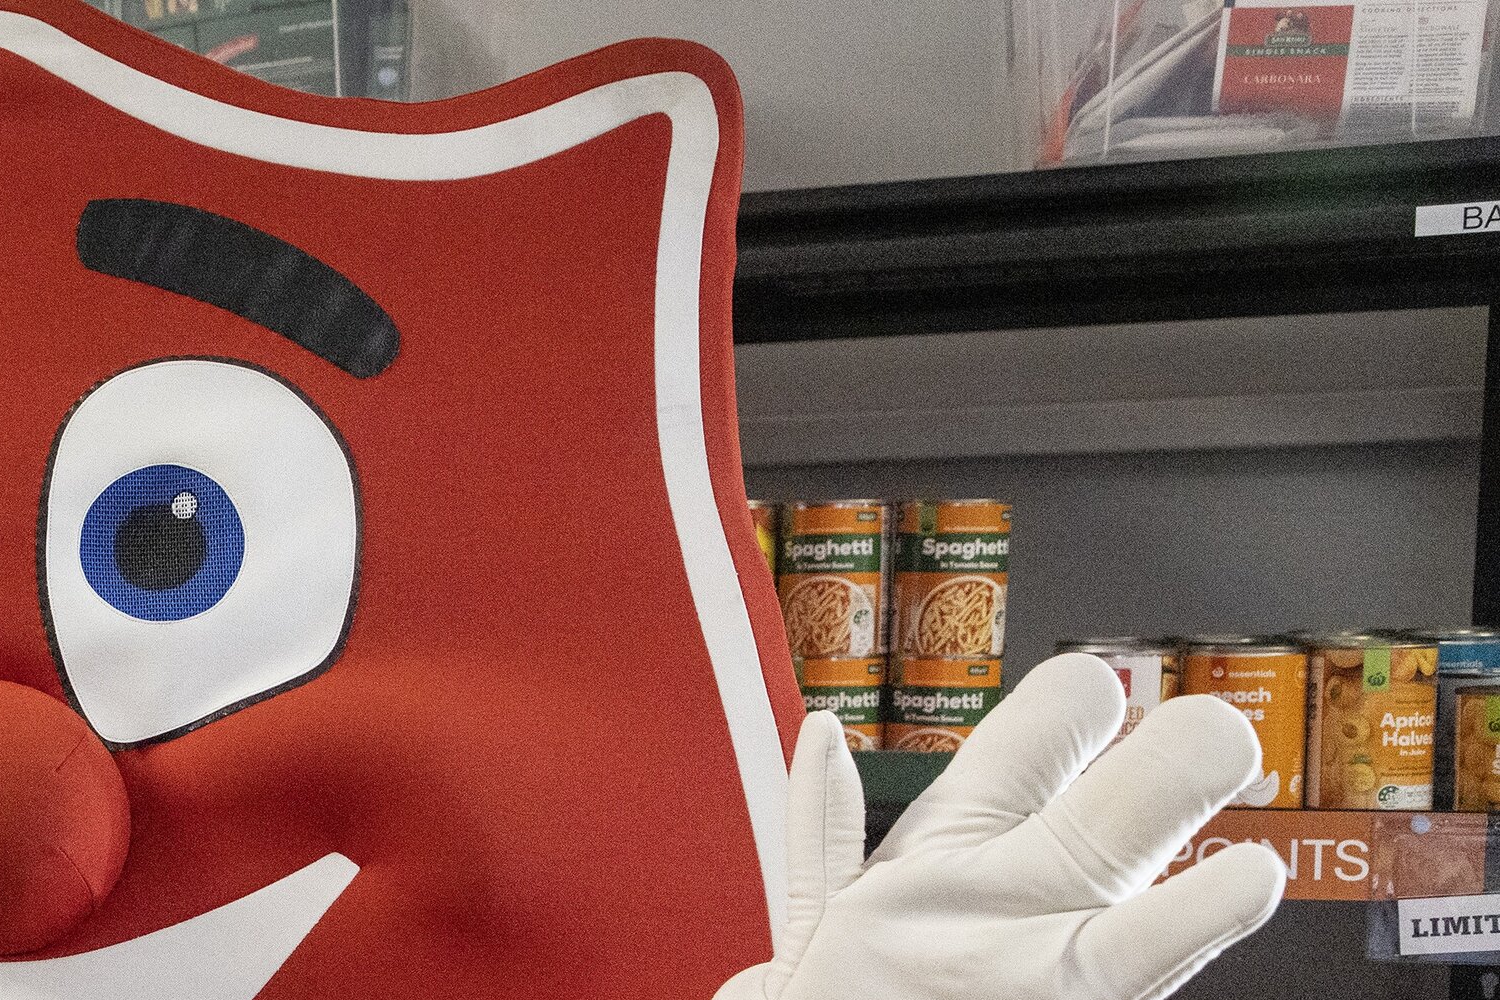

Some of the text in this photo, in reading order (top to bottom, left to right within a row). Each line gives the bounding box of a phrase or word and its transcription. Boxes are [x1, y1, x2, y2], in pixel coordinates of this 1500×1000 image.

[1245, 47, 1328, 56] SINGLE SNACK
[1243, 73, 1323, 85] CARBONARA
[1463, 204, 1500, 230] BA
[785, 537, 874, 560] Spaghetti
[804, 690, 880, 712] paghetti
[893, 689, 984, 712] Spaghetti
[1411, 914, 1500, 938] LIMIT
